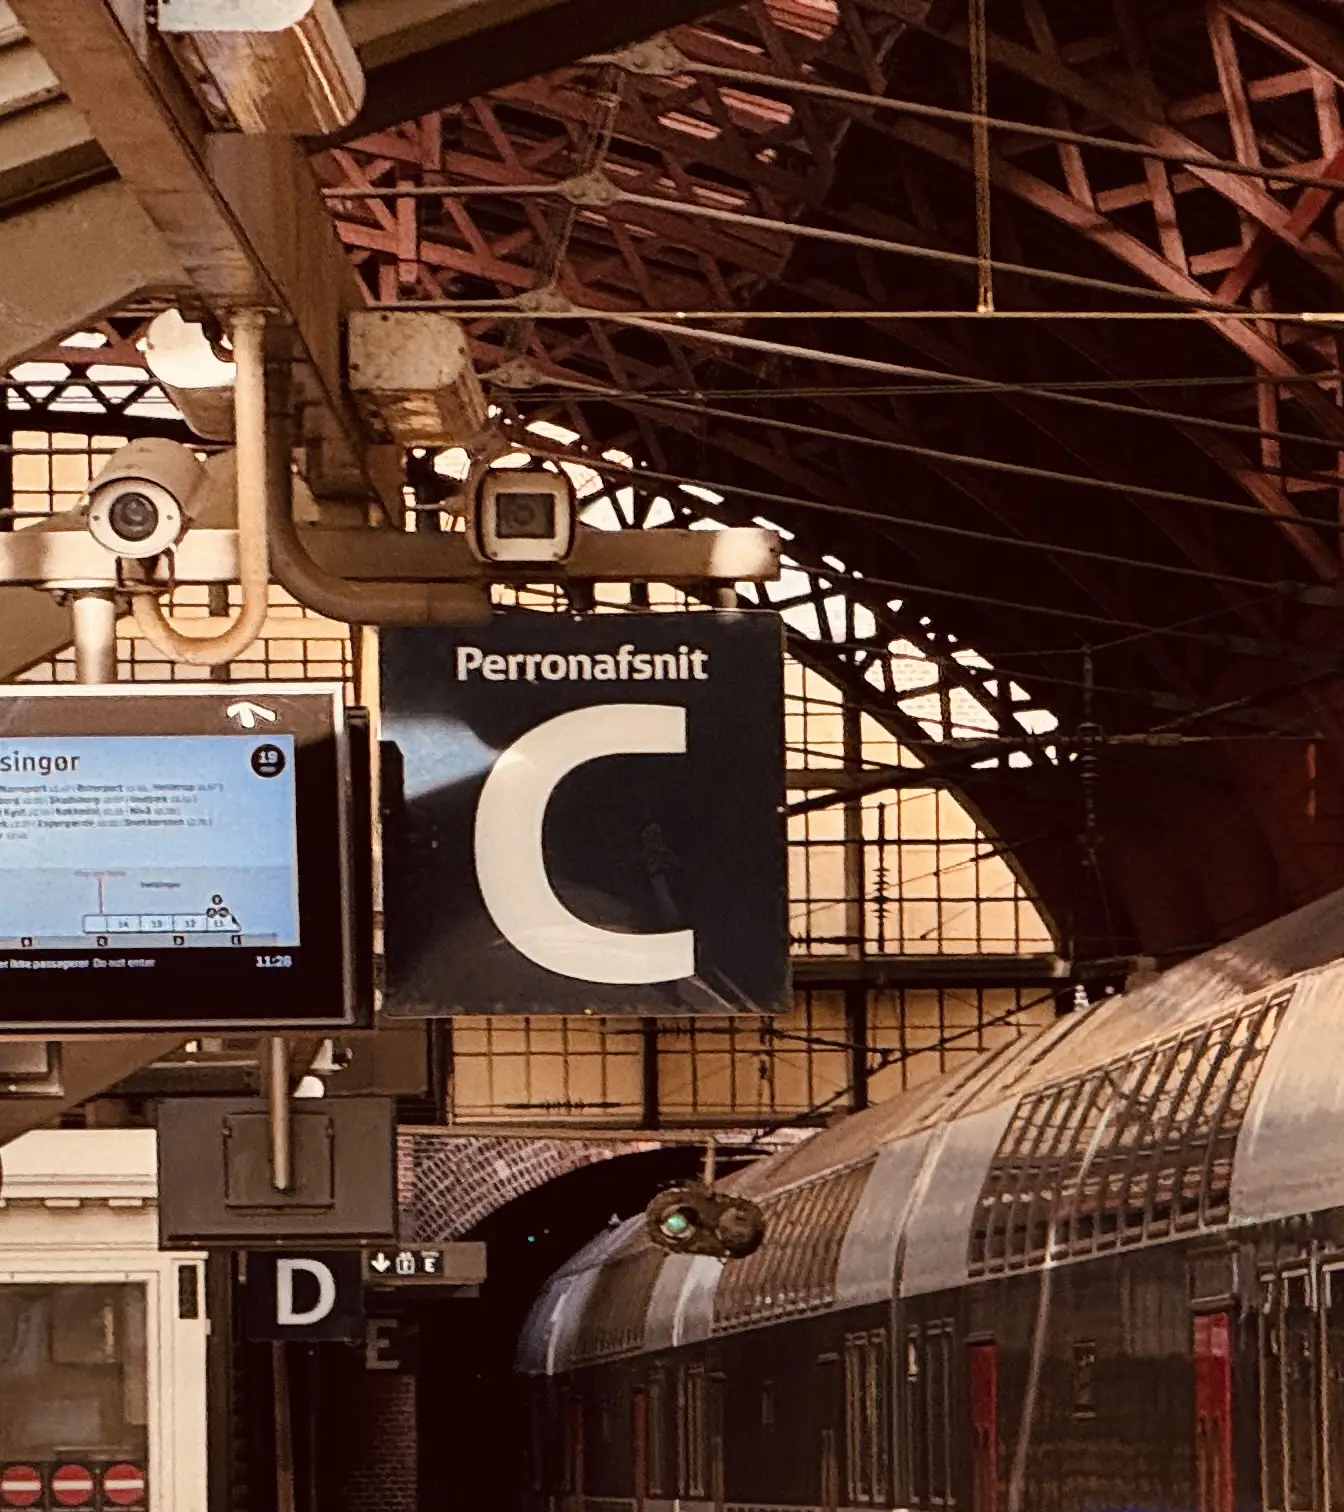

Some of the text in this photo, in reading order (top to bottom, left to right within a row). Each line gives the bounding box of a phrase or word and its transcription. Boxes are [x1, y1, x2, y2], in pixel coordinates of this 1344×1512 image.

[457, 645, 709, 681] Perronafsnit
[475, 704, 695, 984] C
[276, 1258, 336, 1325] D
[366, 1318, 399, 1370] E
